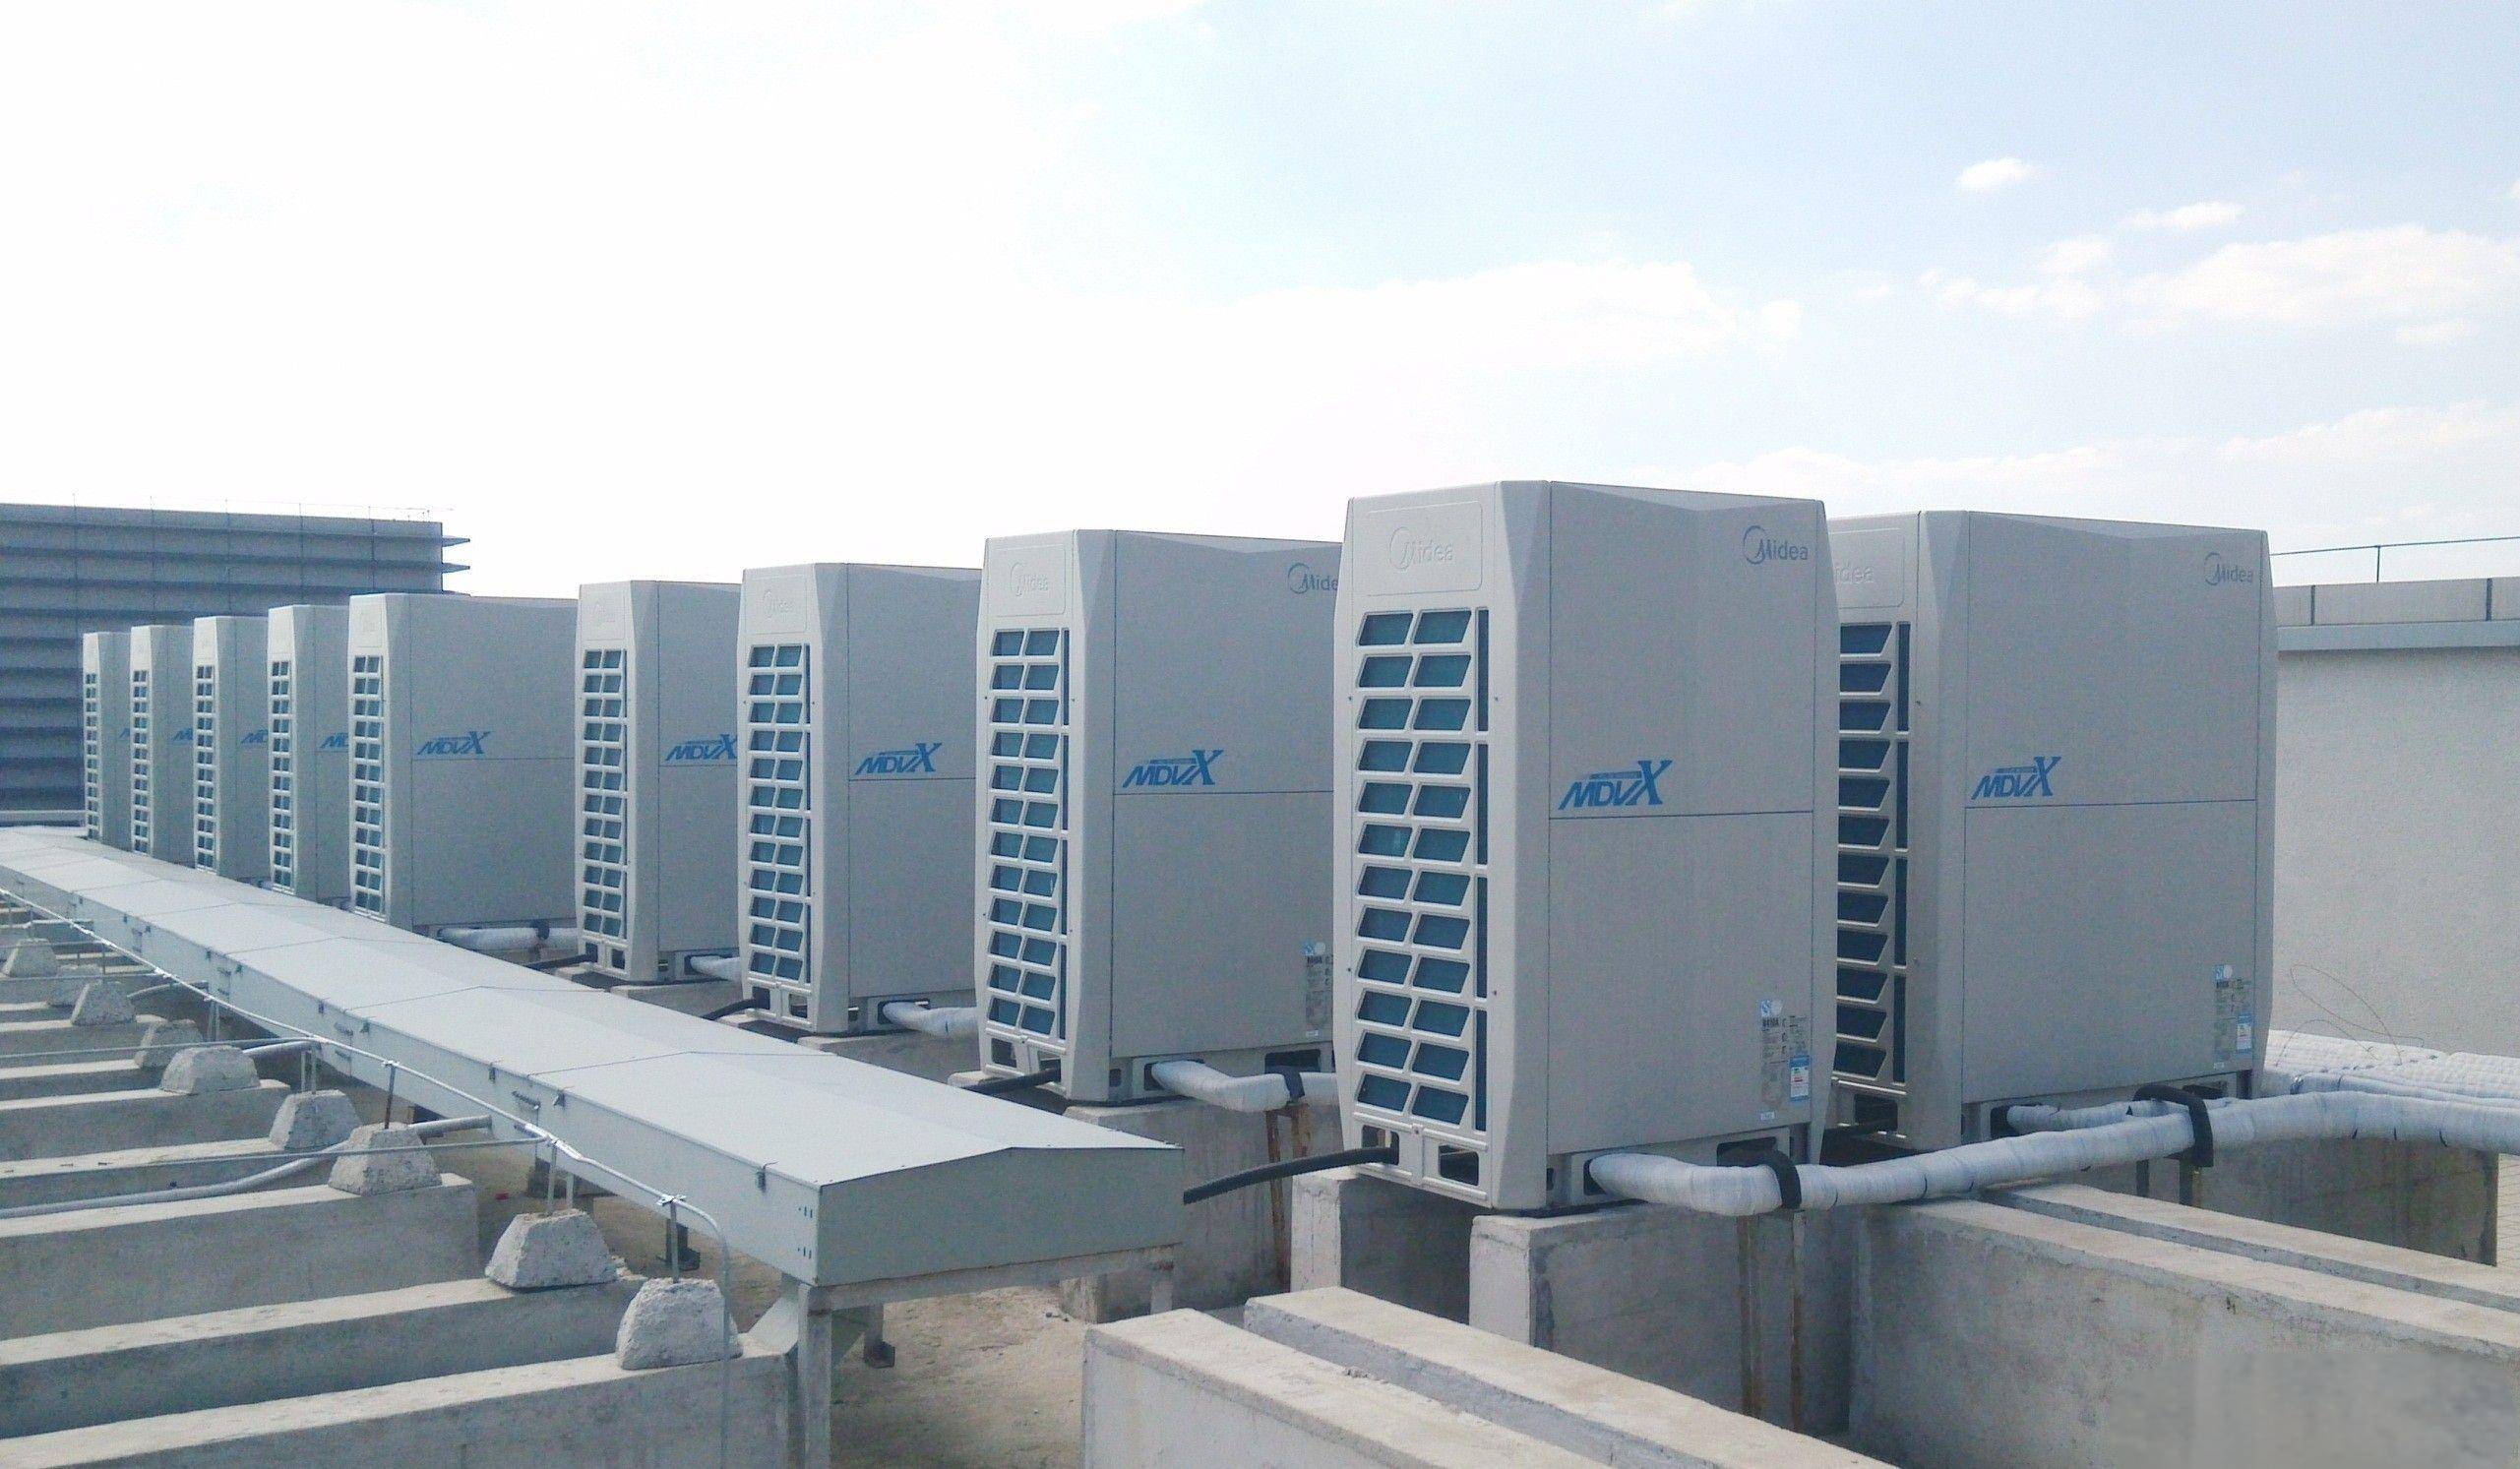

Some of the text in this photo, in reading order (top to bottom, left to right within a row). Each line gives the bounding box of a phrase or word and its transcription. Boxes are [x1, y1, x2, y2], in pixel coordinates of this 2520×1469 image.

[1833, 559, 1875, 583] idea
[854, 742, 943, 775] MDVX
[1122, 749, 1224, 788] MDVX
[1971, 756, 2061, 800] MDVX
[1558, 760, 1673, 810] MDVX
